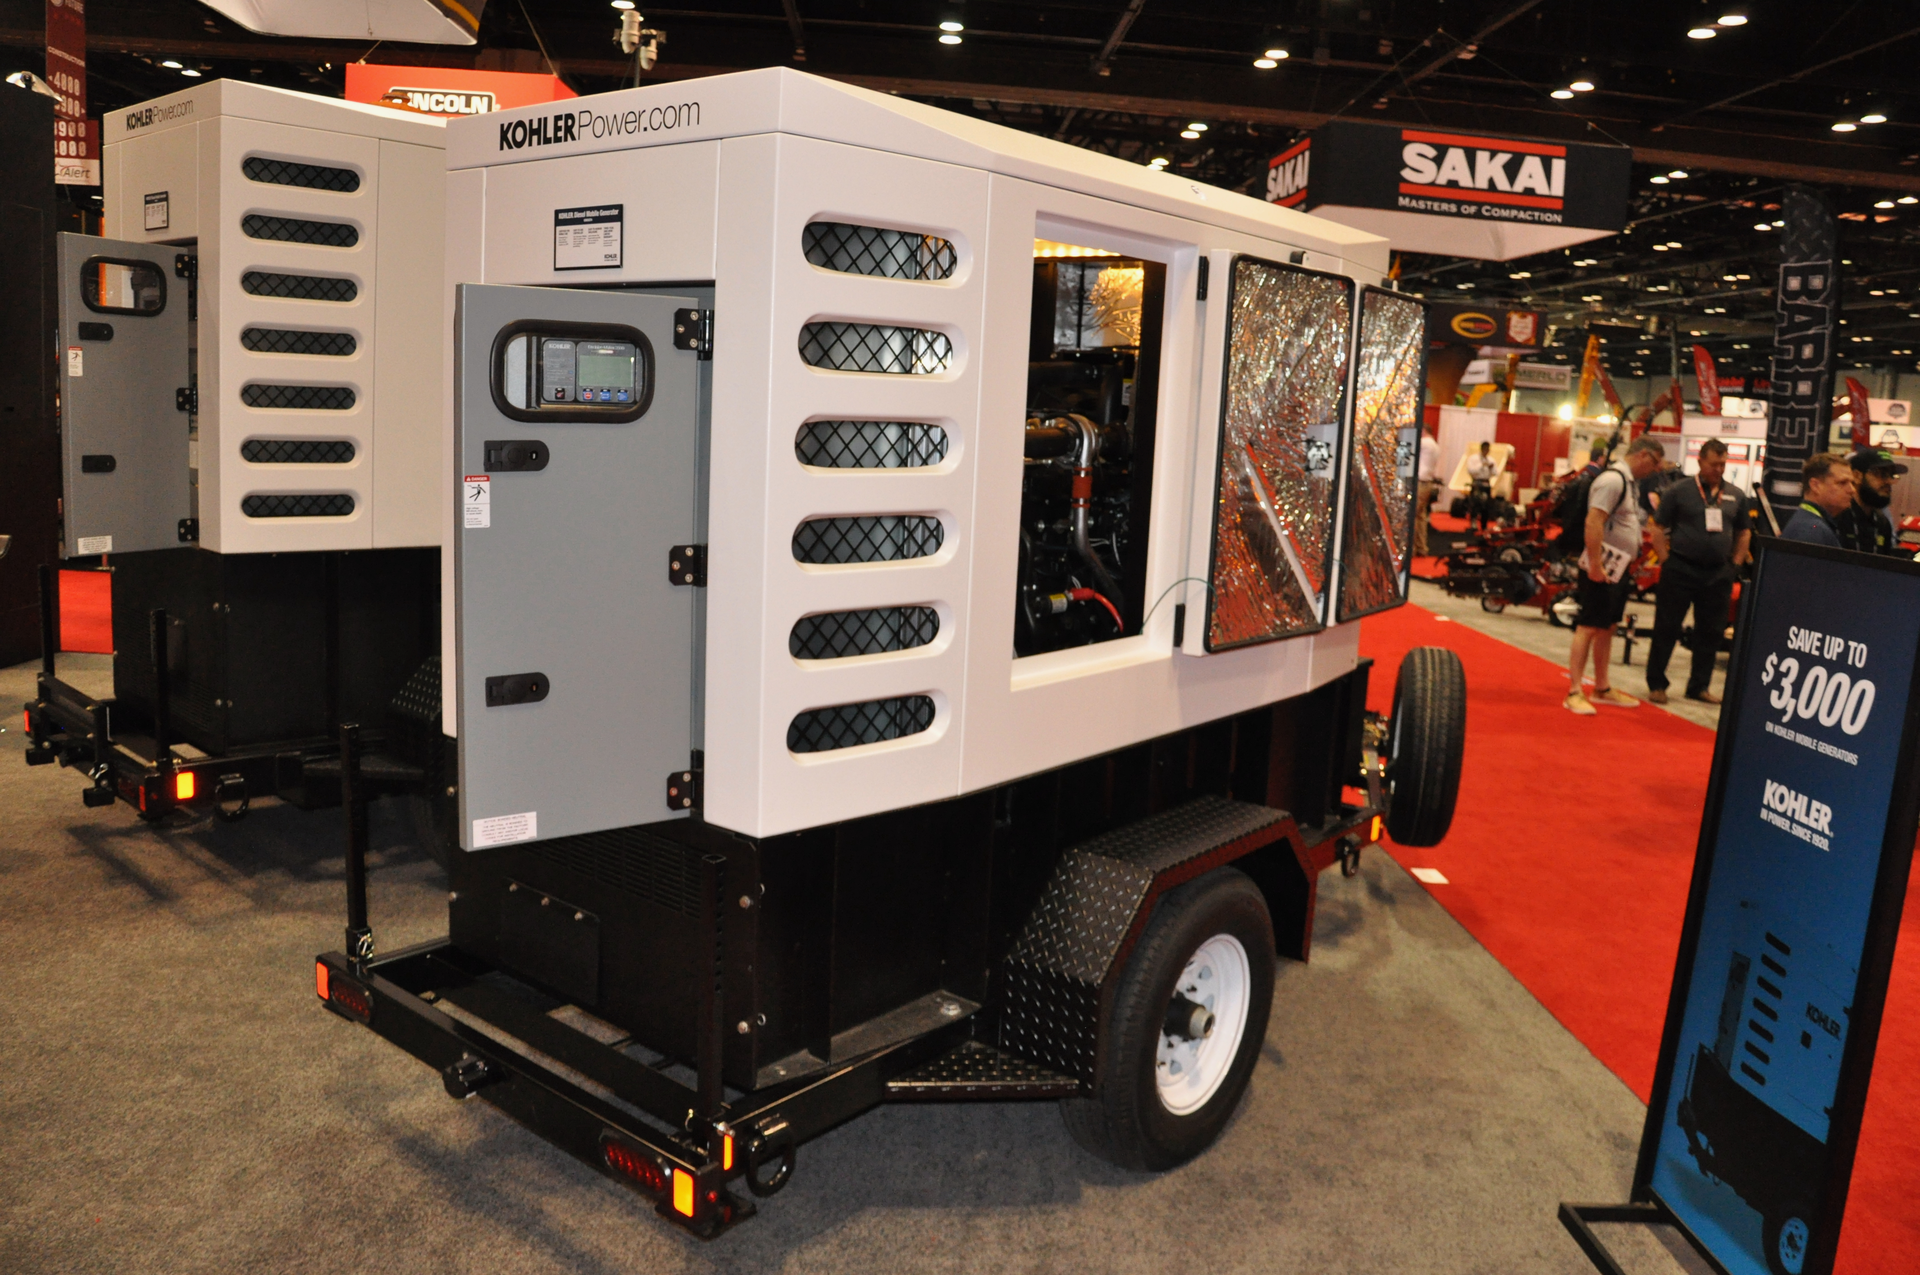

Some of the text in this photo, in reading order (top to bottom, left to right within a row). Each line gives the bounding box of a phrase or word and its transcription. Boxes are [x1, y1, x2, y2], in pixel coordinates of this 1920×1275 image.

[53, 71, 80, 96] 4000
[405, 91, 489, 114] INCOLN
[126, 100, 194, 131] KOHLERPower.com
[499, 101, 700, 151] KOHLERPower.com
[1265, 149, 1310, 203] SAKAI
[1400, 141, 1566, 197] SAKAI
[1787, 625, 1868, 669] SAVE UP TO
[1761, 651, 1876, 736] $3,000
[1764, 720, 1859, 766] ON KOHLER MOBILE GENERATORS
[1806, 1001, 1842, 1041] KOHLER
